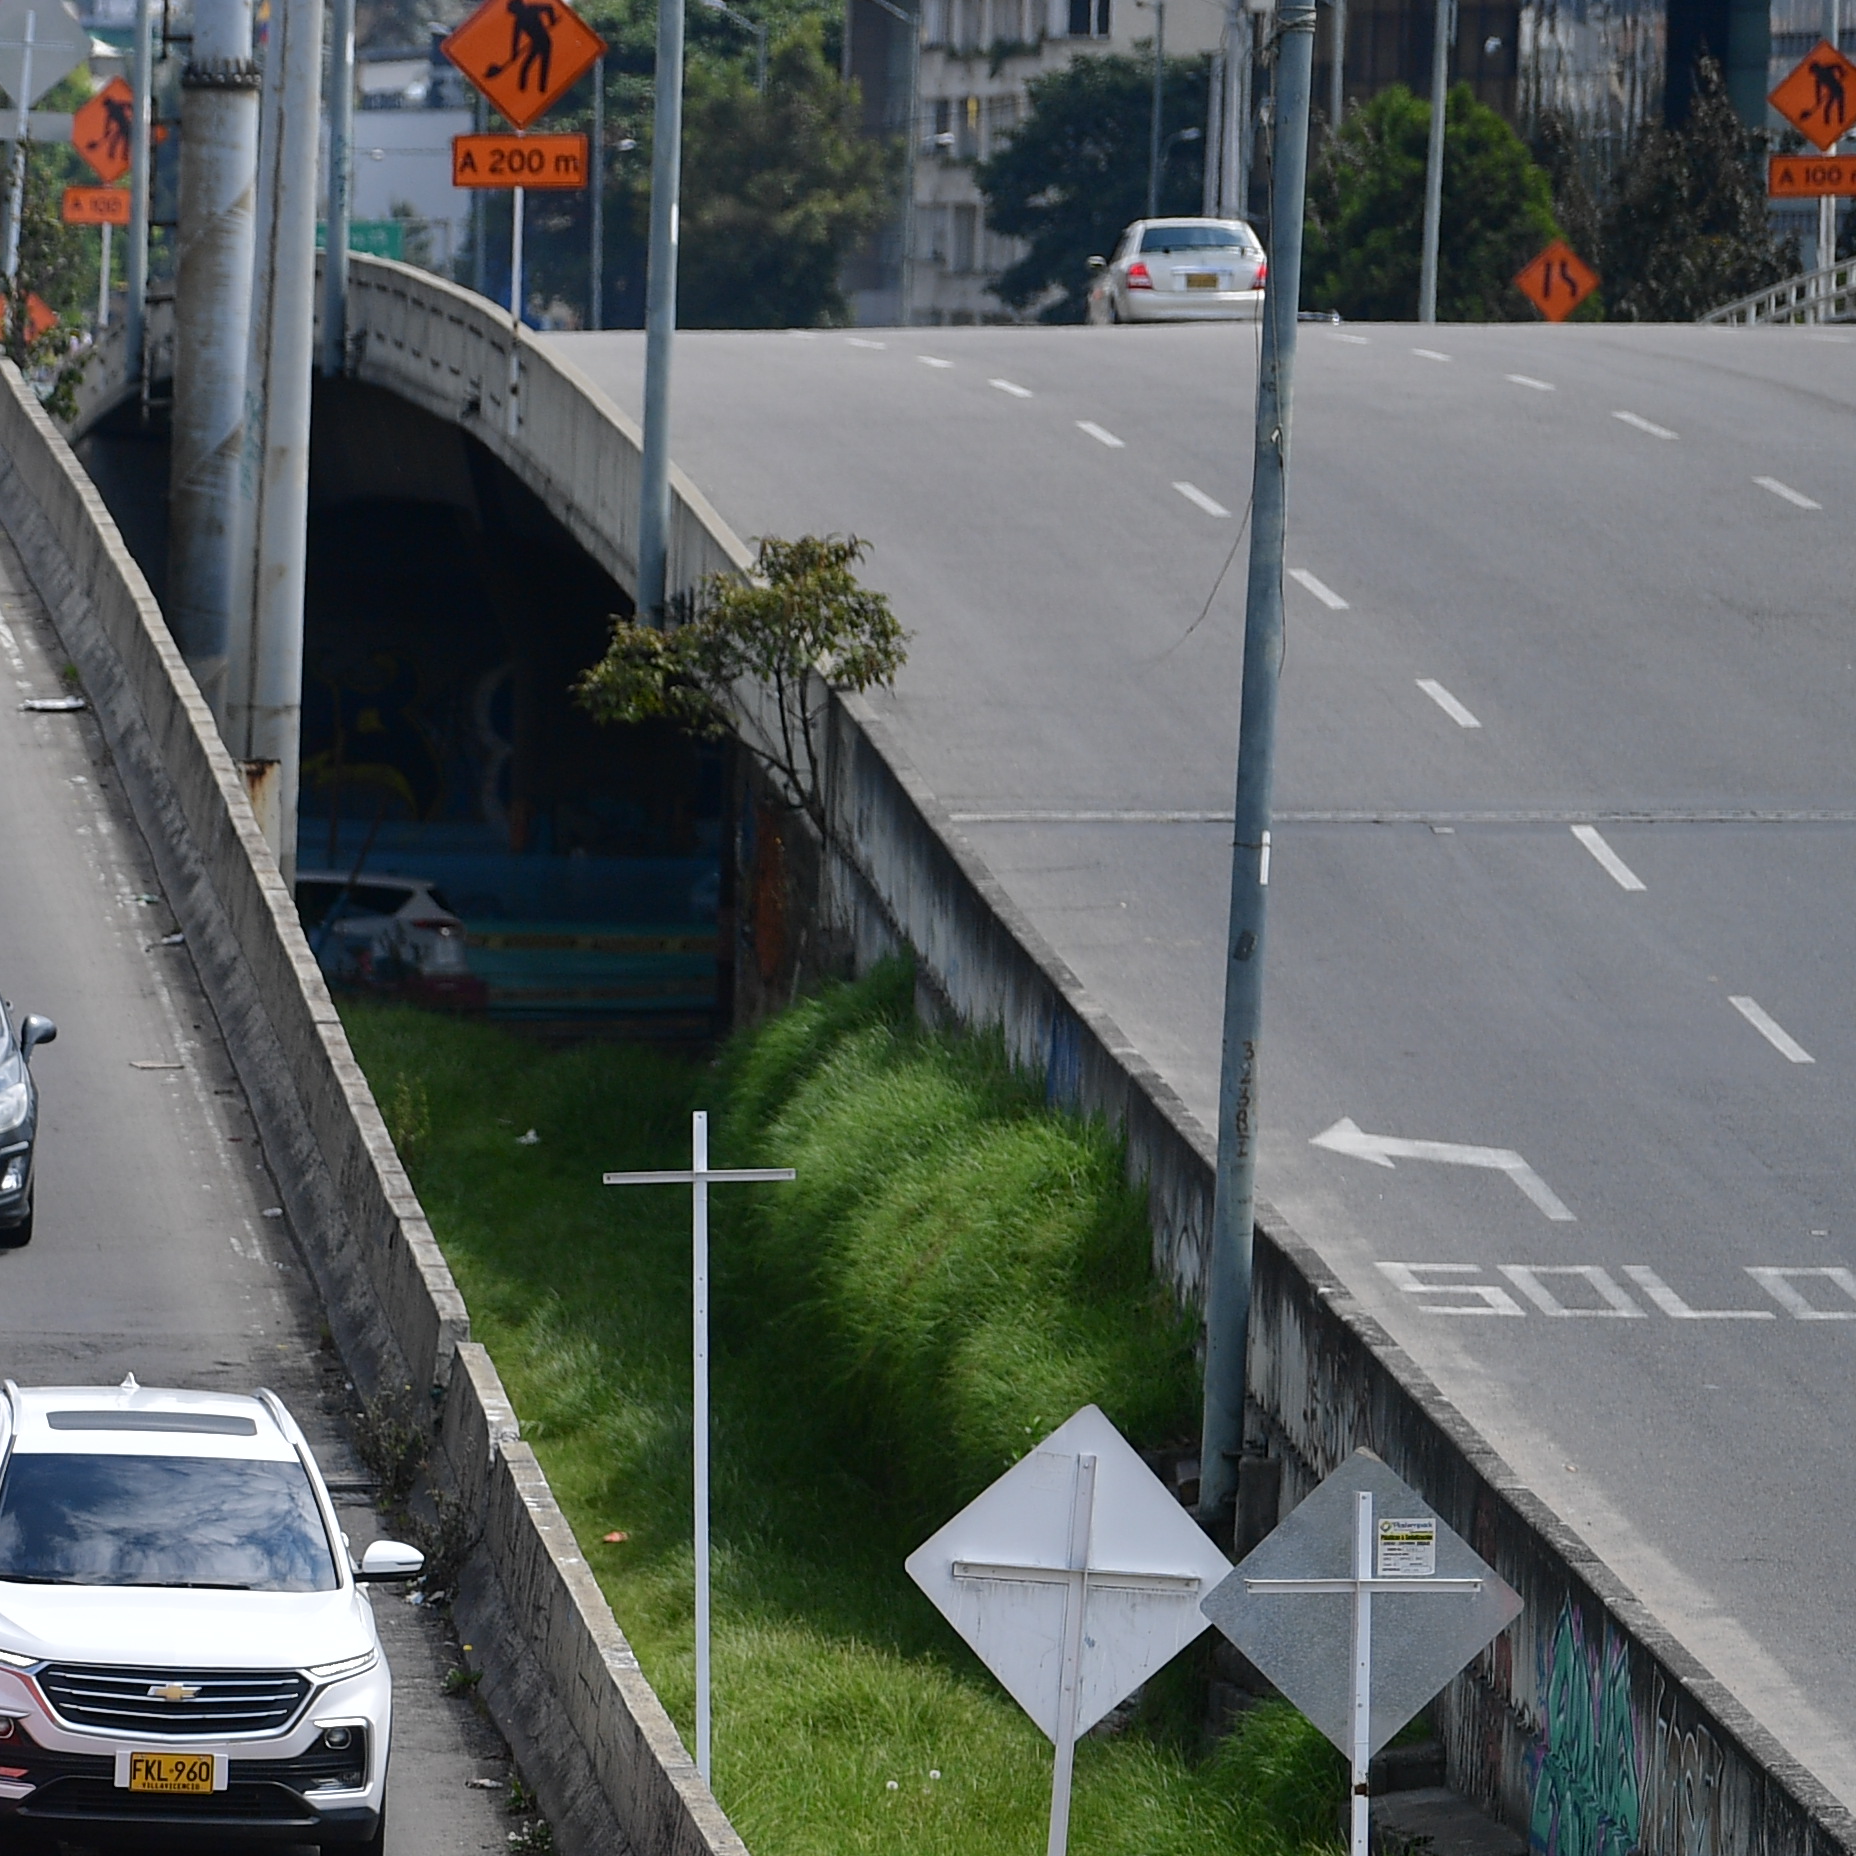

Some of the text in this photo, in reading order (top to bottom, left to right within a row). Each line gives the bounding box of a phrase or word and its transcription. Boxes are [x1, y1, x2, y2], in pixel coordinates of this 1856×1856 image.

[459, 149, 579, 174] A 200 m
[1779, 167, 1794, 185] A
[1805, 165, 1842, 186] 100
[1373, 1261, 1856, 1320] SOLO
